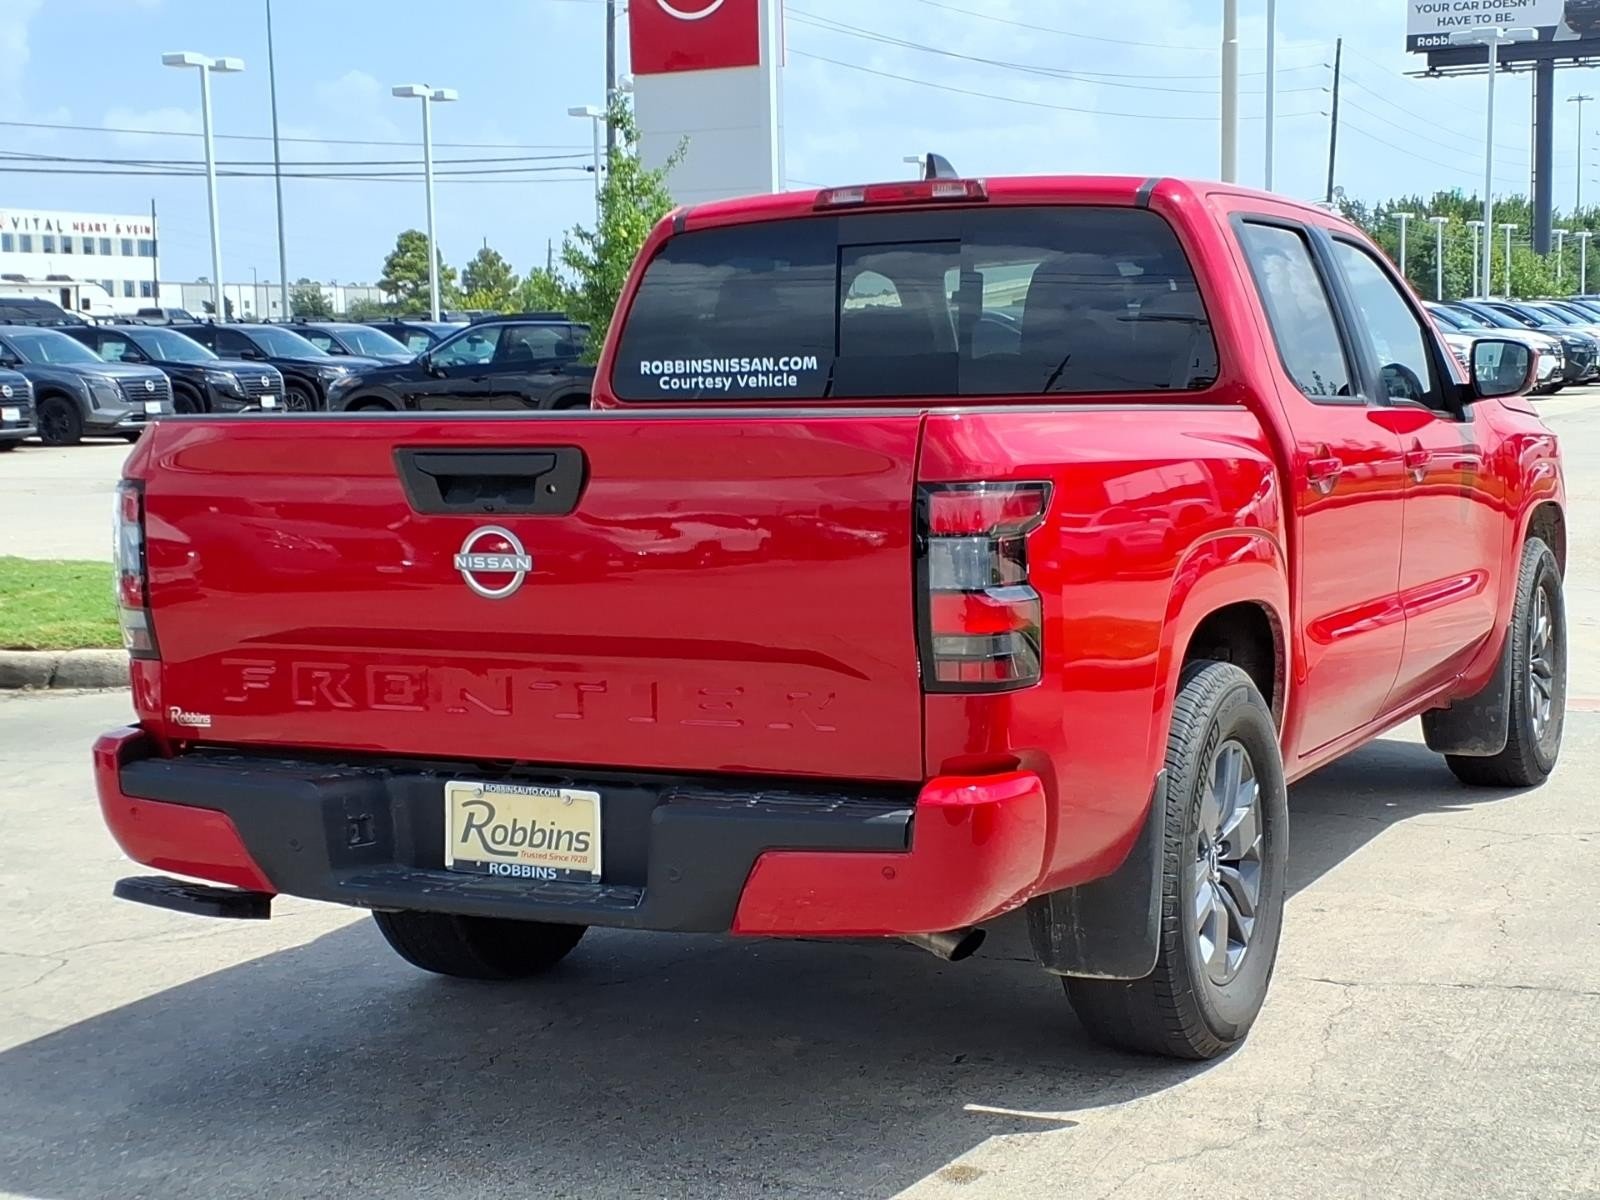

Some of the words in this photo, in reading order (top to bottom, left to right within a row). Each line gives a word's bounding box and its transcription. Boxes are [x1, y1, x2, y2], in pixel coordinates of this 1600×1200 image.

[1415, 3, 1450, 14] YOUR
[1453, 1, 1479, 12] CAR
[1437, 15, 1471, 26] HAVE
[1474, 14, 1492, 24] TO
[1495, 12, 1515, 22] BE.
[1417, 35, 1451, 46] Robb
[11, 217, 63, 233] VITAL
[72, 222, 107, 234] HEART
[126, 224, 151, 235] VEIN
[640, 356, 818, 375] ROBBINSNISSAN.COM
[659, 374, 732, 391] Courtesy
[737, 373, 797, 388] Vehicle
[456, 556, 529, 569] NISSAN
[221, 657, 836, 732] FRONTIER
[169, 706, 211, 727] Robbins
[485, 784, 558, 797] ROBBINSAUTO.COM
[461, 800, 591, 857] Robbins
[521, 850, 547, 860] Trusted
[549, 853, 568, 862] Since
[570, 855, 588, 864] 1928
[489, 863, 557, 880] ROBBINS
